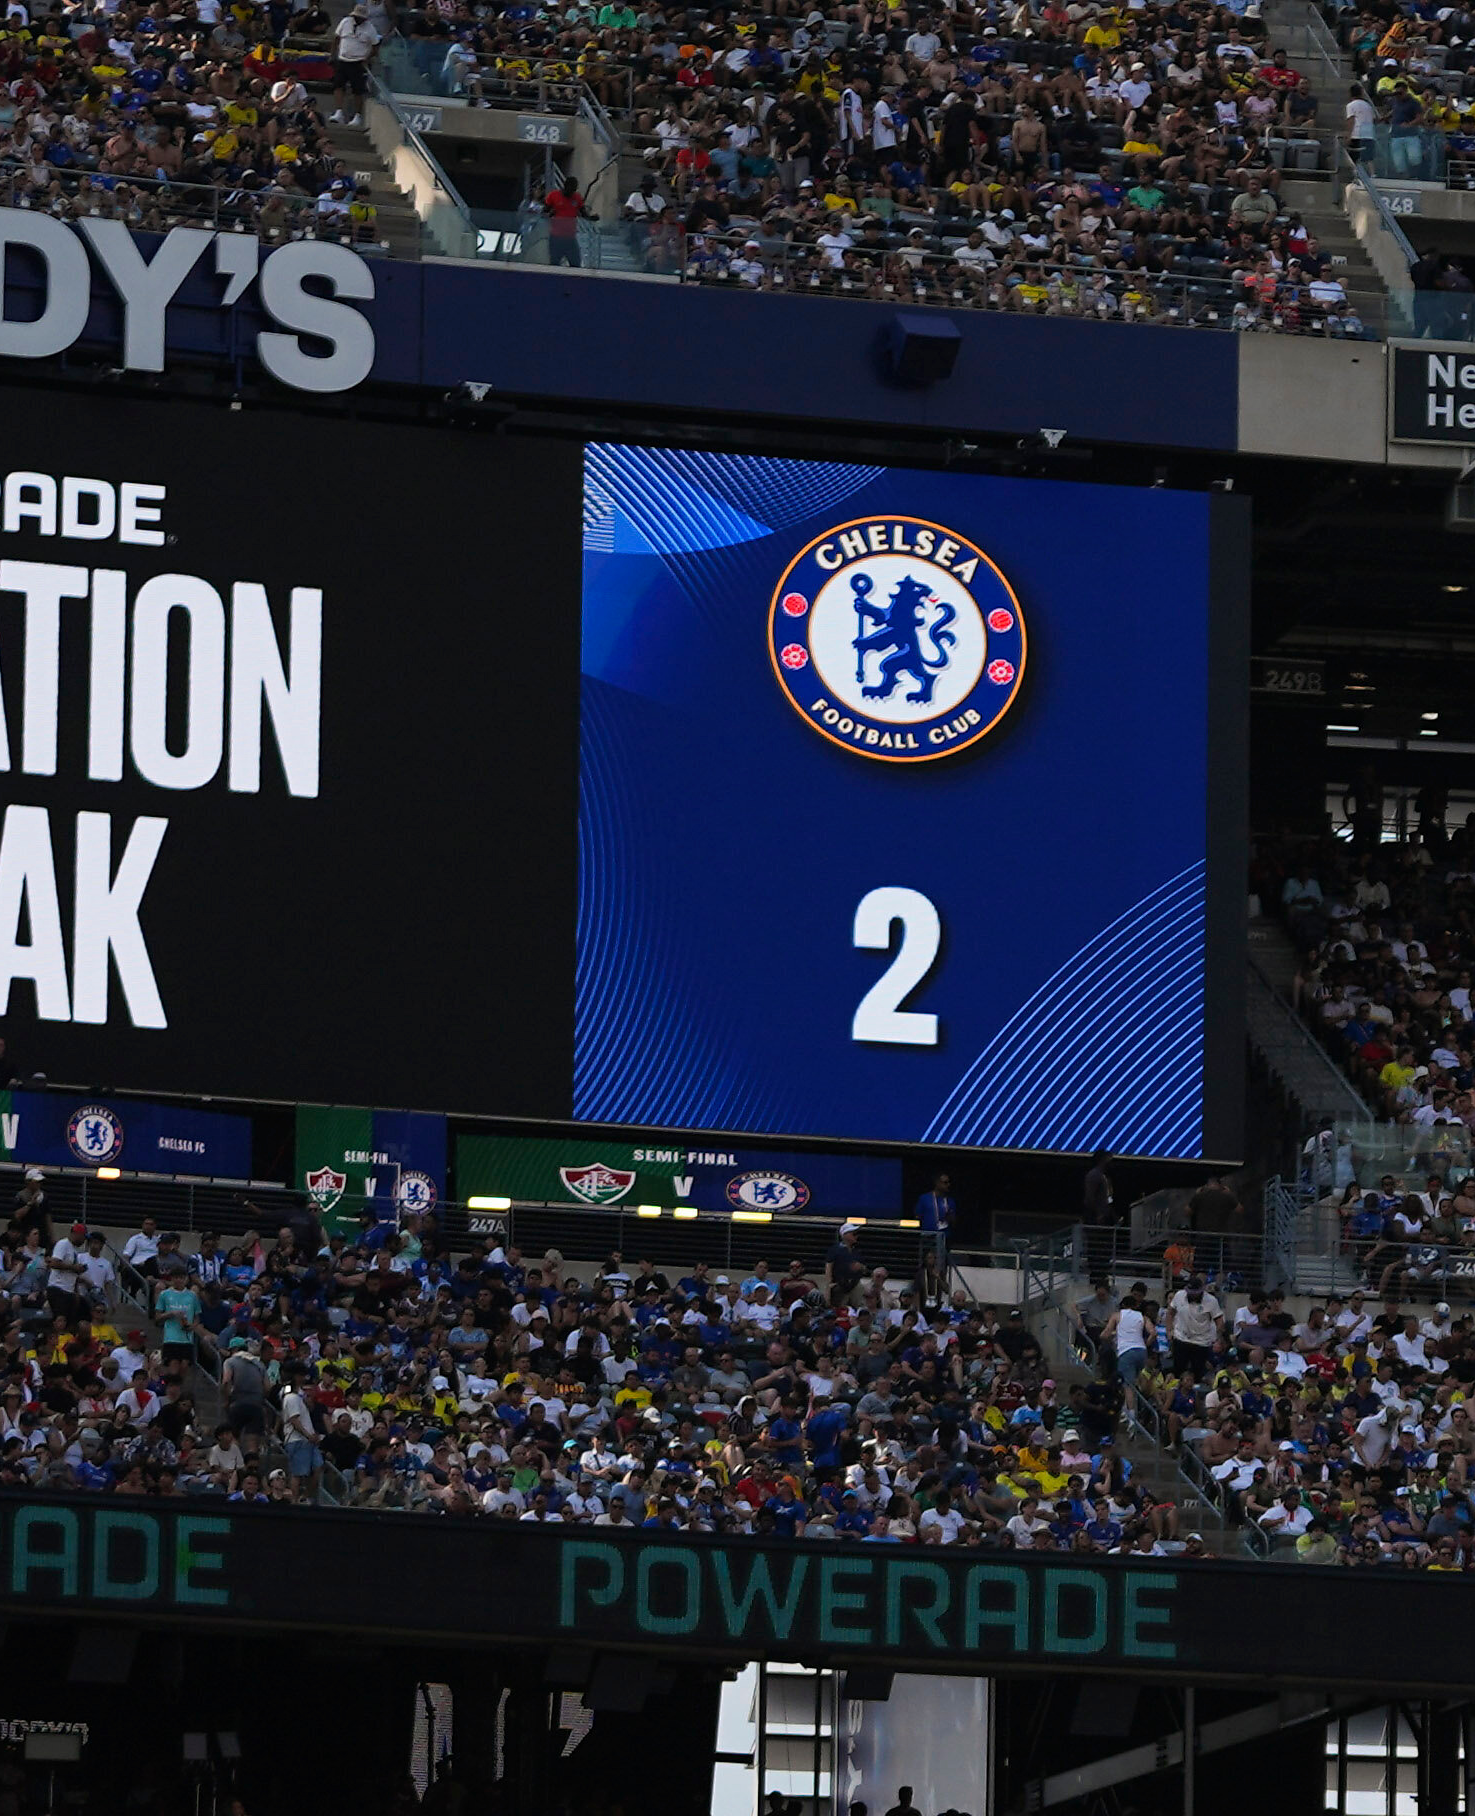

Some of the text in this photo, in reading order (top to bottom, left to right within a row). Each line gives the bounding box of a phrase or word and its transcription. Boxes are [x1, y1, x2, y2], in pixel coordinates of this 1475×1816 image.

[524, 122, 562, 143] 348
[814, 523, 982, 585] CHELSEA
[1266, 669, 1323, 691] 249B
[810, 697, 984, 751] FOOTBALL CLUB
[852, 886, 941, 1045] 2
[1, 1112, 20, 1150] V
[158, 1136, 206, 1154] CHELSEA FC
[633, 1149, 738, 1166] SEMI-FINAL
[365, 1177, 377, 1198] V
[673, 1175, 694, 1197] V
[470, 1218, 506, 1234] 247A
[559, 1541, 1178, 1660] POWERADE
